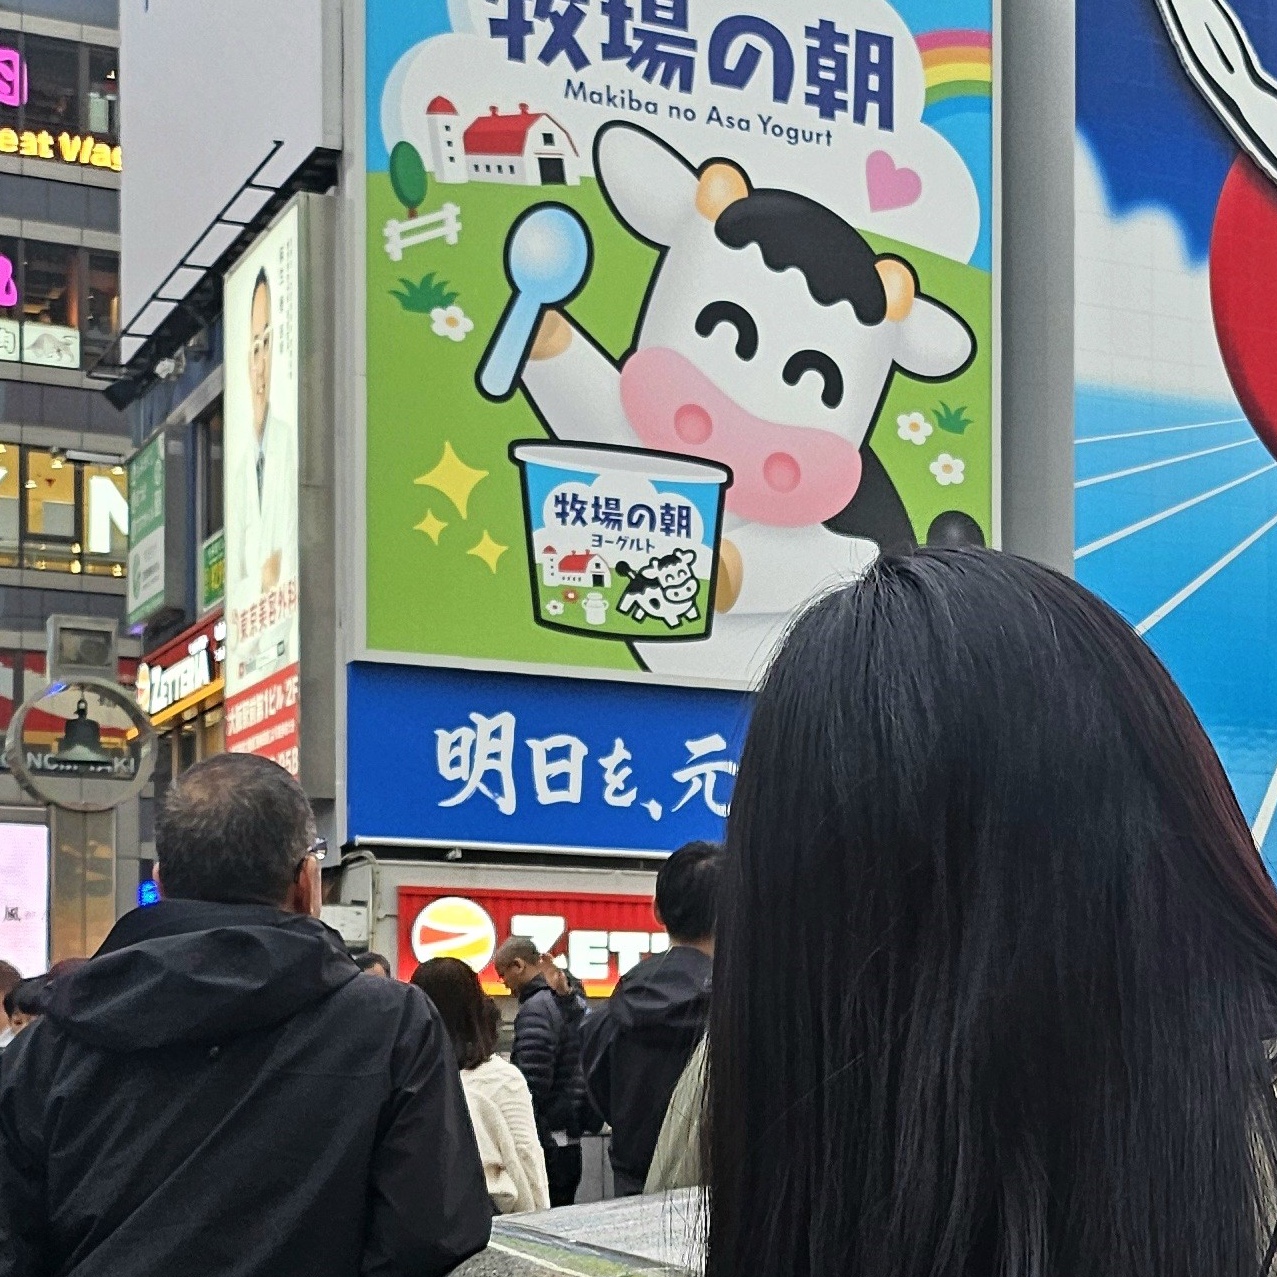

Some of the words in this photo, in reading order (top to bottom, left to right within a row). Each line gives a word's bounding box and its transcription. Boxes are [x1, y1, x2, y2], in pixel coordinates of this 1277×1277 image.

[487, 0, 896, 133] 牧場の朝
[563, 78, 660, 116] Makiba
[668, 104, 697, 122] no
[706, 106, 751, 133] Asa
[757, 114, 833, 147] Yogurt
[554, 492, 692, 539] 牧場の朝
[591, 533, 656, 555] ヨーグルト
